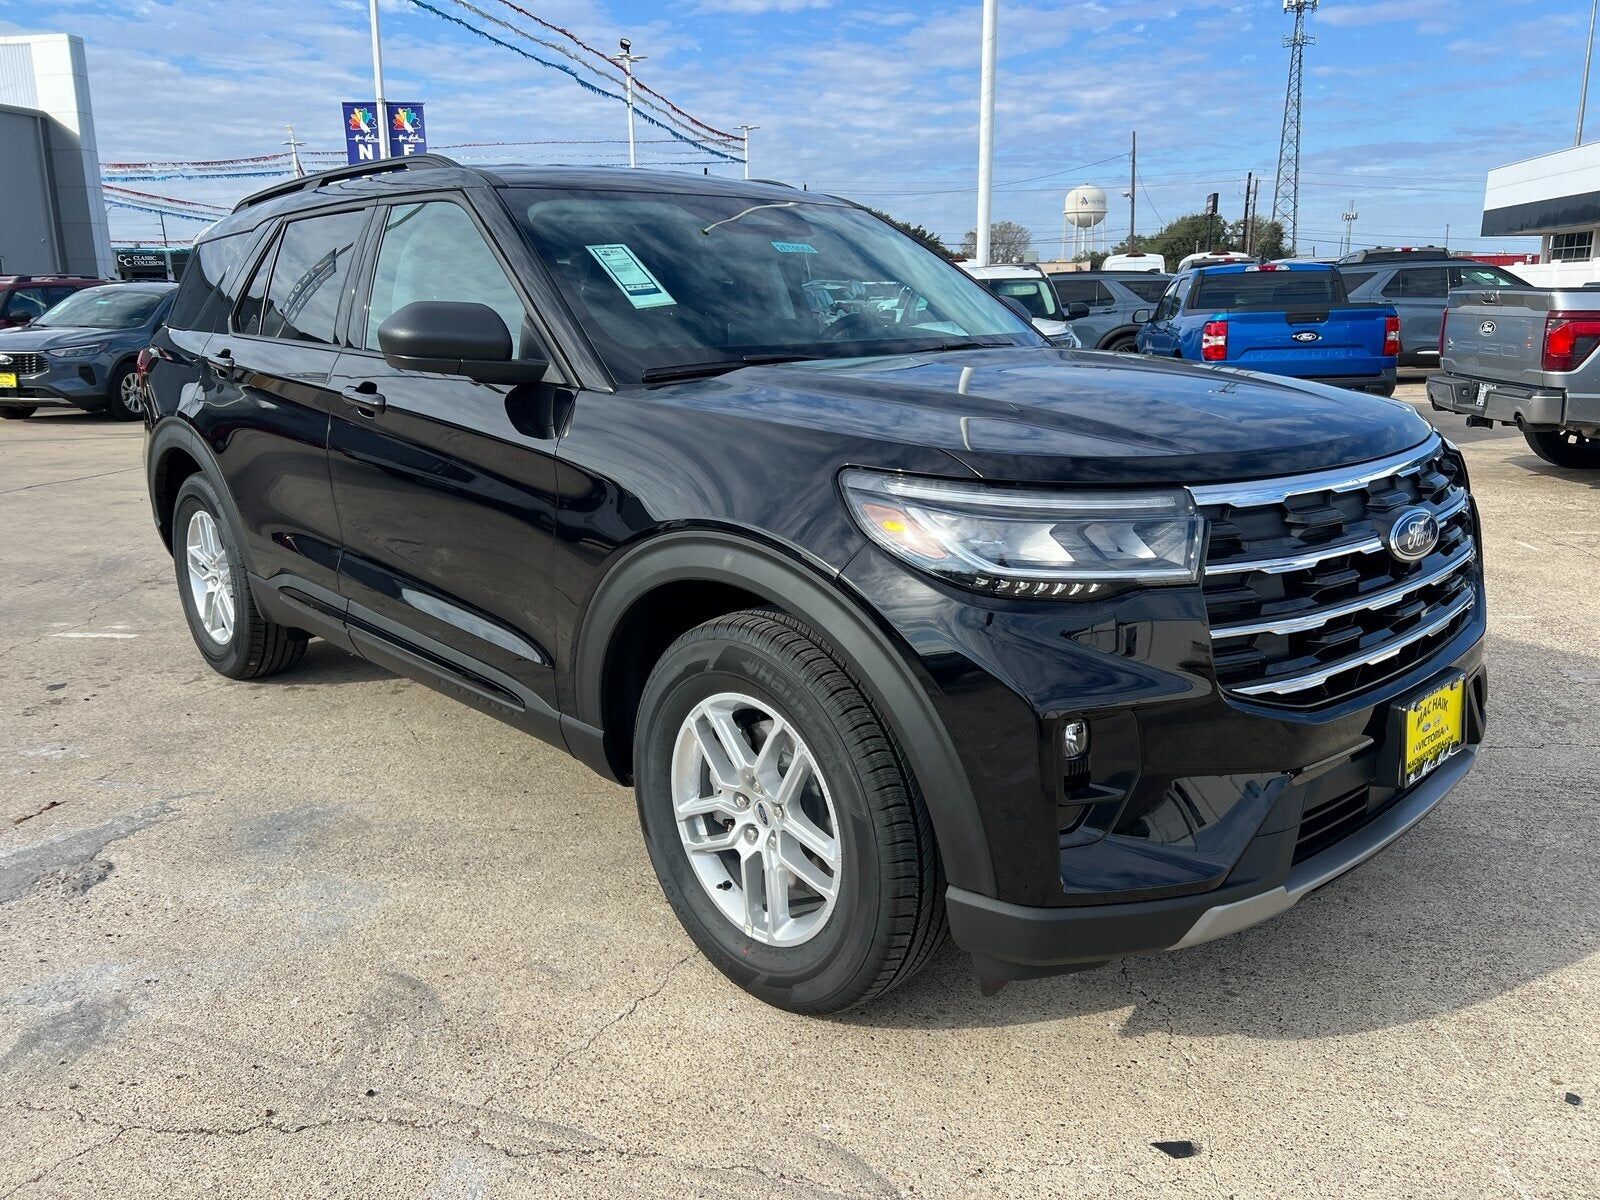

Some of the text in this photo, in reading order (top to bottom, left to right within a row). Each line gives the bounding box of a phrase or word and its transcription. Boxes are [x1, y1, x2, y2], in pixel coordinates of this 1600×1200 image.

[1407, 521, 1433, 550] Ford
[1416, 696, 1449, 730] MAC HAIK
